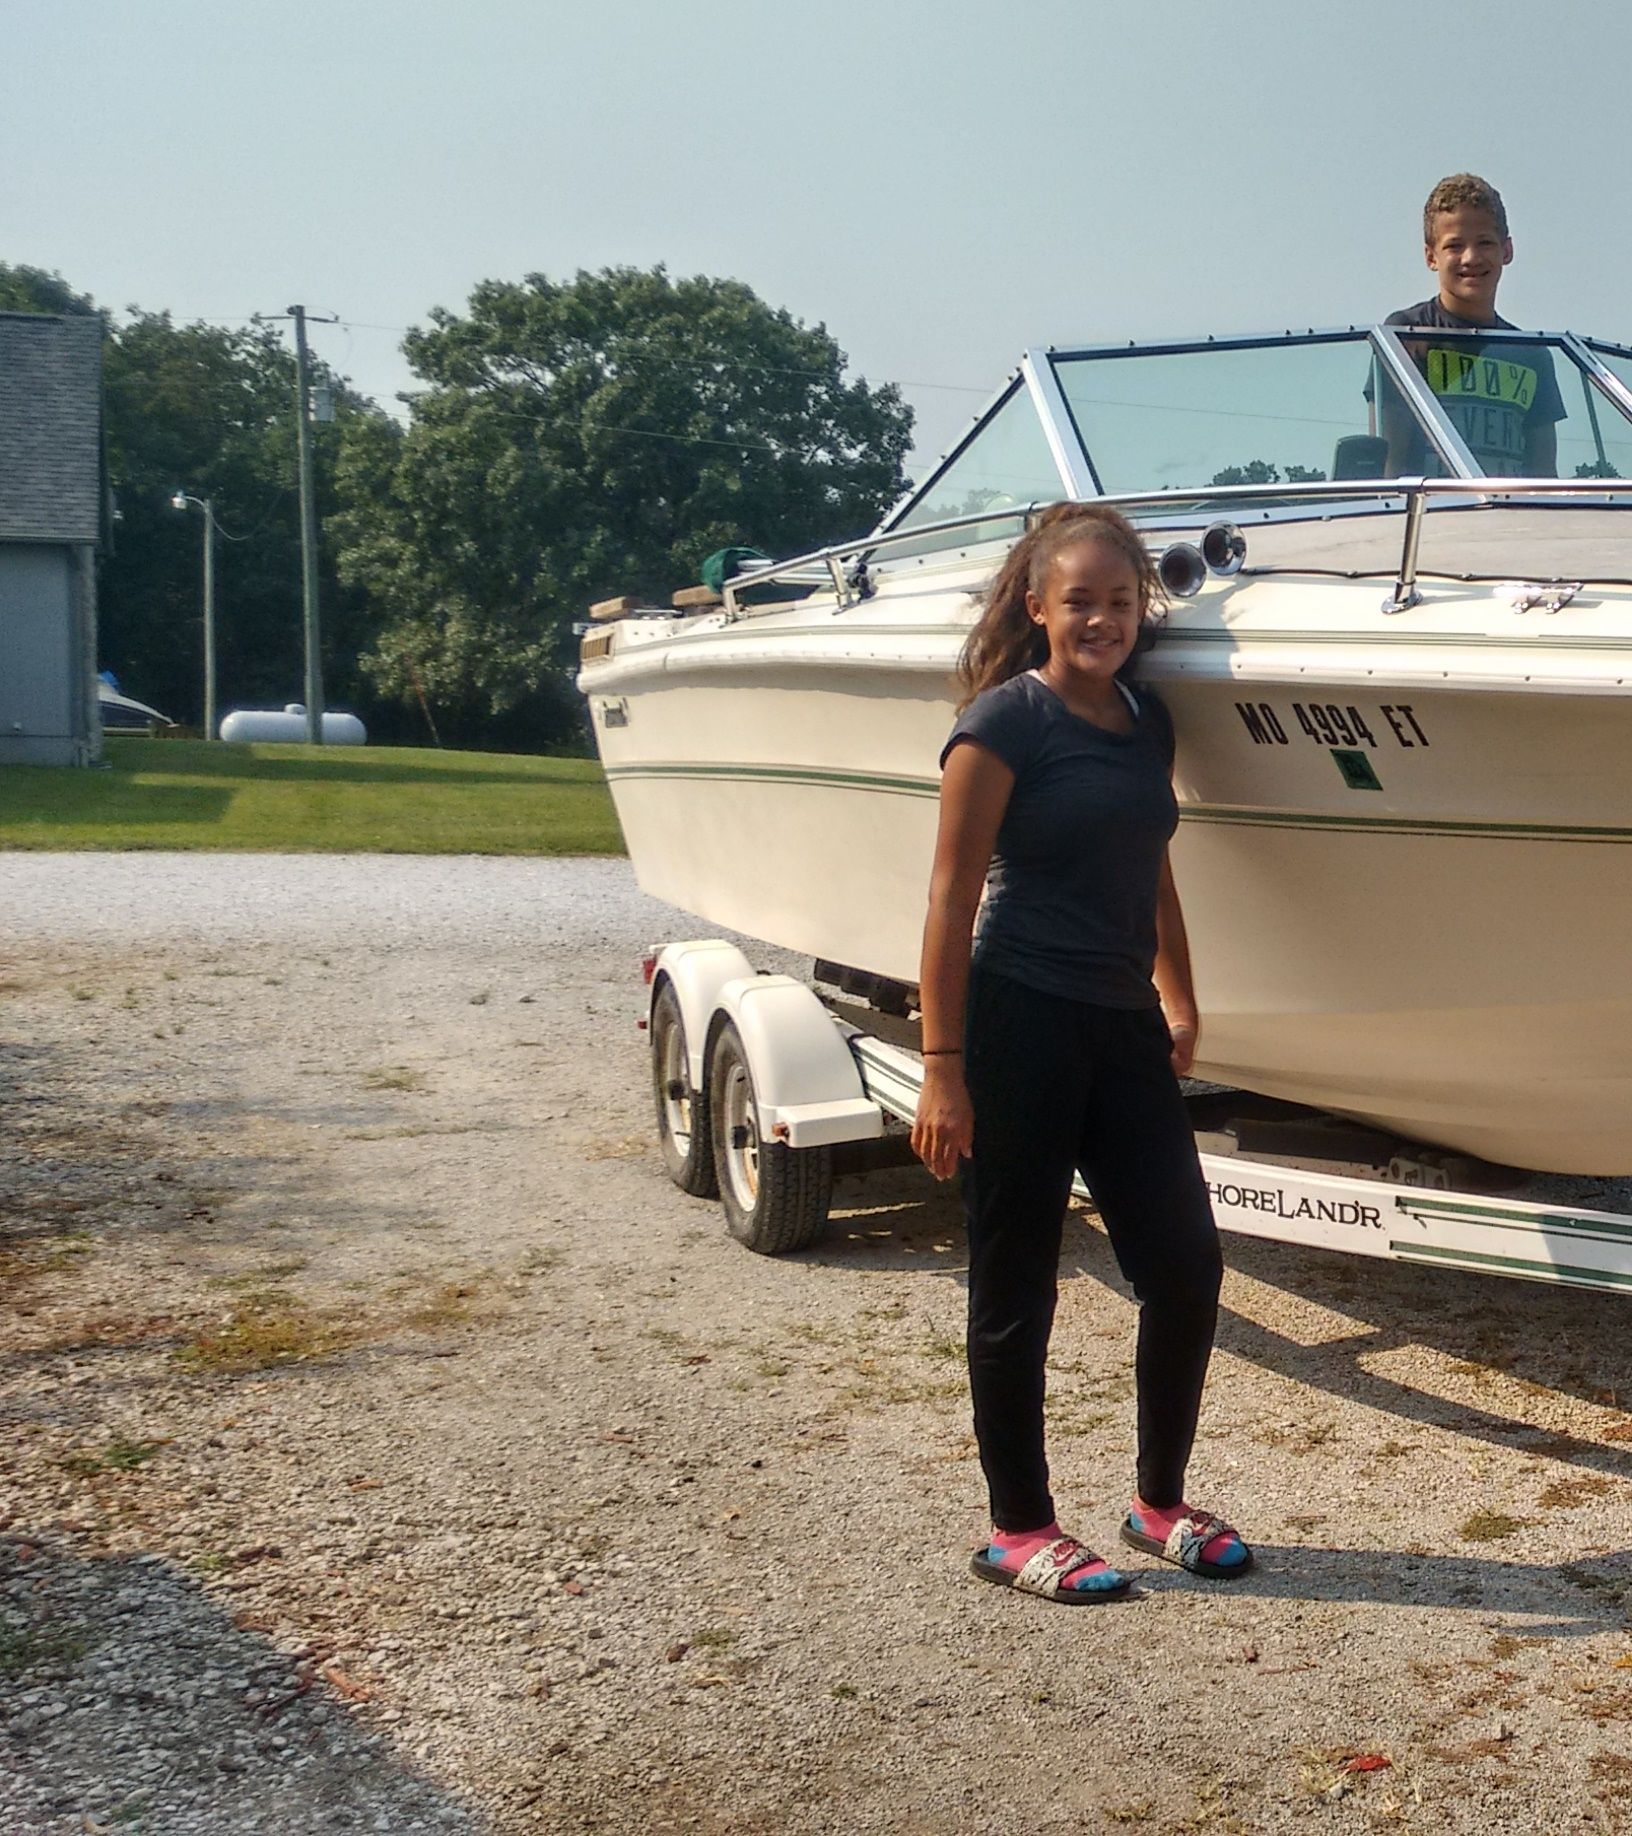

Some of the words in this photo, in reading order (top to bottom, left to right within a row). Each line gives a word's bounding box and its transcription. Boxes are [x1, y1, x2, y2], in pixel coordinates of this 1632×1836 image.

[1440, 351, 1529, 406] 100%
[1234, 701, 1290, 745] MO
[1292, 702, 1378, 748] 4994
[1379, 703, 1430, 748] ET
[1204, 1180, 1383, 1230] HORELAND'R
